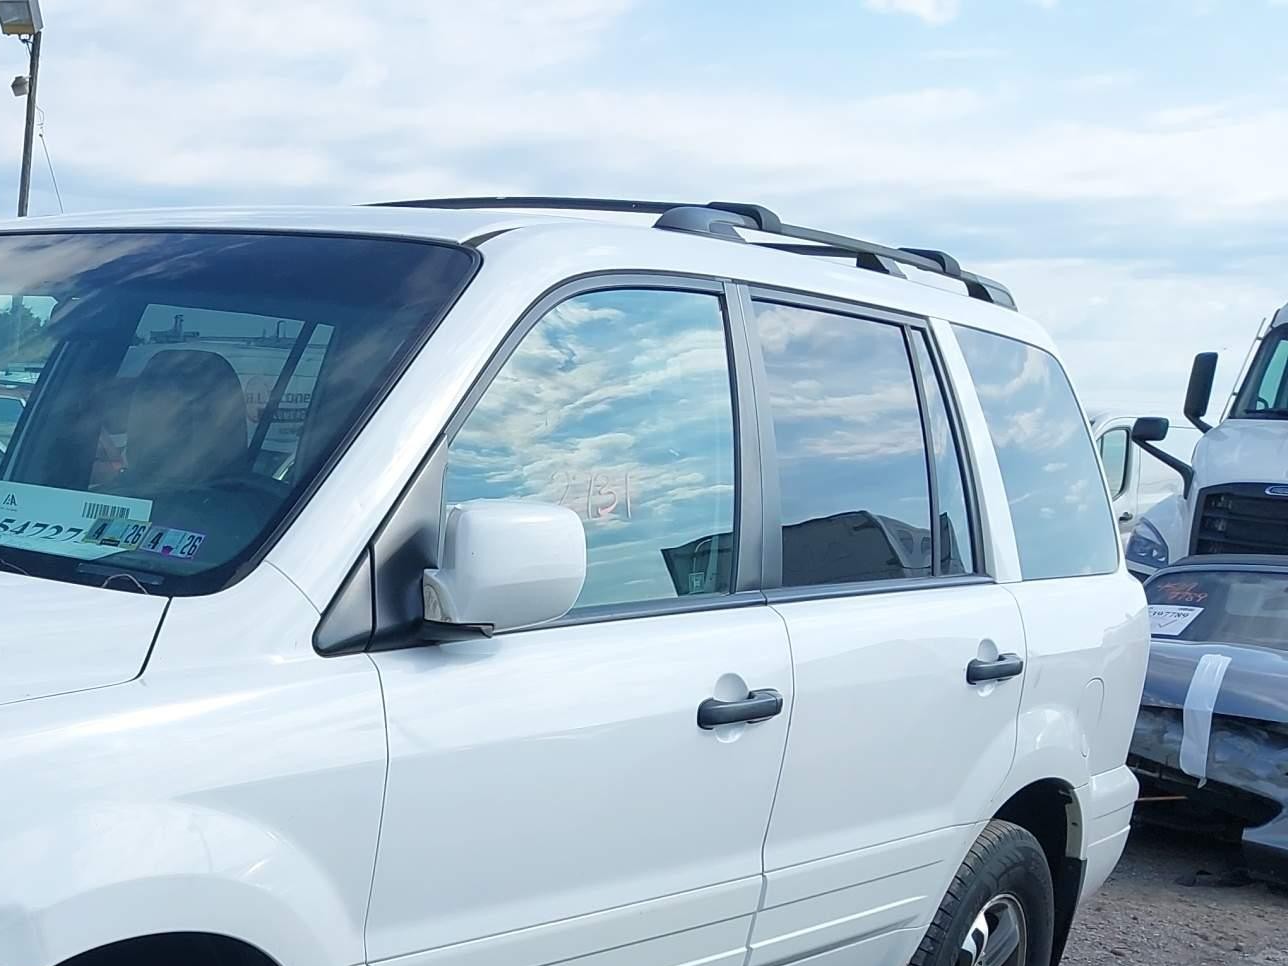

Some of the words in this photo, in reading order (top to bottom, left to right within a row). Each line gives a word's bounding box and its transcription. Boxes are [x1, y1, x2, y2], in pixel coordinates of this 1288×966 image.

[93, 523, 108, 540] 4
[124, 524, 146, 545] 26
[148, 532, 164, 549] 4
[180, 535, 202, 556] 26
